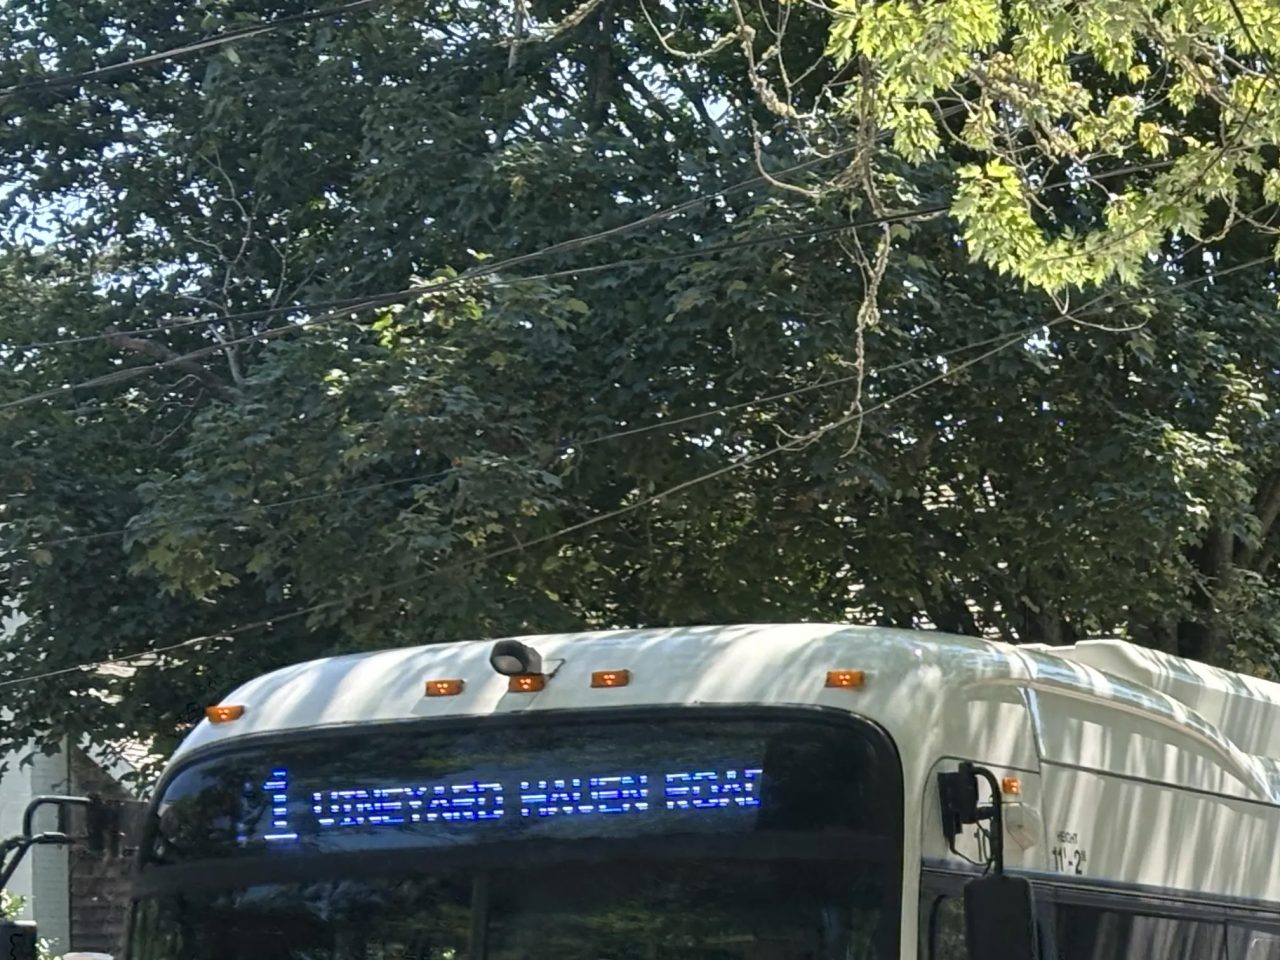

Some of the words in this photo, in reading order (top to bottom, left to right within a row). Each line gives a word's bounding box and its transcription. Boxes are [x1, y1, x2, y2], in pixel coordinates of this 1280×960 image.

[262, 768, 298, 840] 1
[312, 783, 504, 827] VINEYARD
[520, 775, 648, 816] HAVEN
